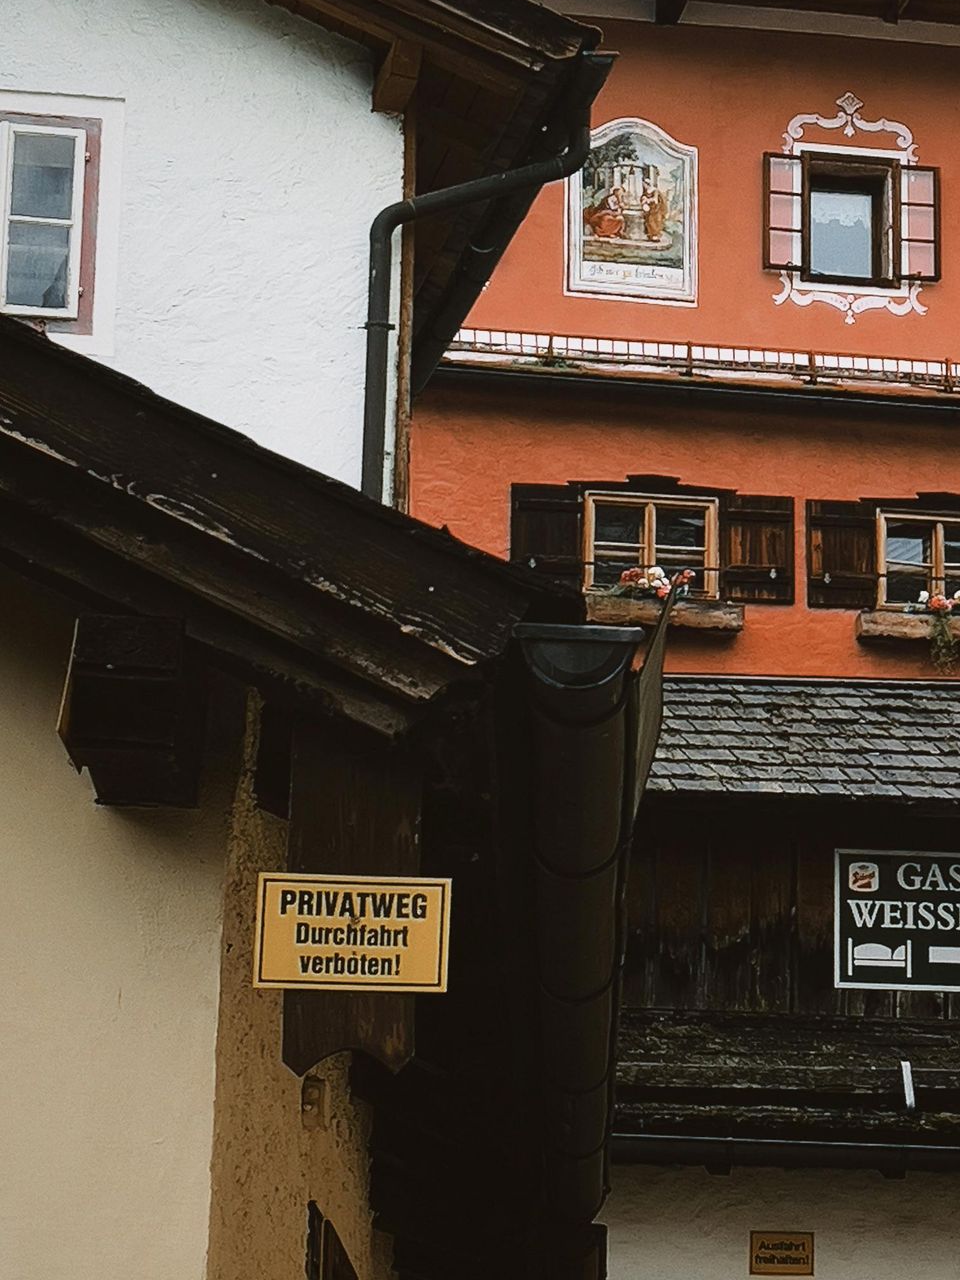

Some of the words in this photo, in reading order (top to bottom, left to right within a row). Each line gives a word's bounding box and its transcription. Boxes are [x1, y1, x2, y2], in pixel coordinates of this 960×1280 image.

[280, 889, 428, 919] PRIVATWEG
[296, 922, 409, 947] Durchfahrt
[300, 952, 401, 976] verboten!
[759, 1240, 806, 1252] Ausfahrt
